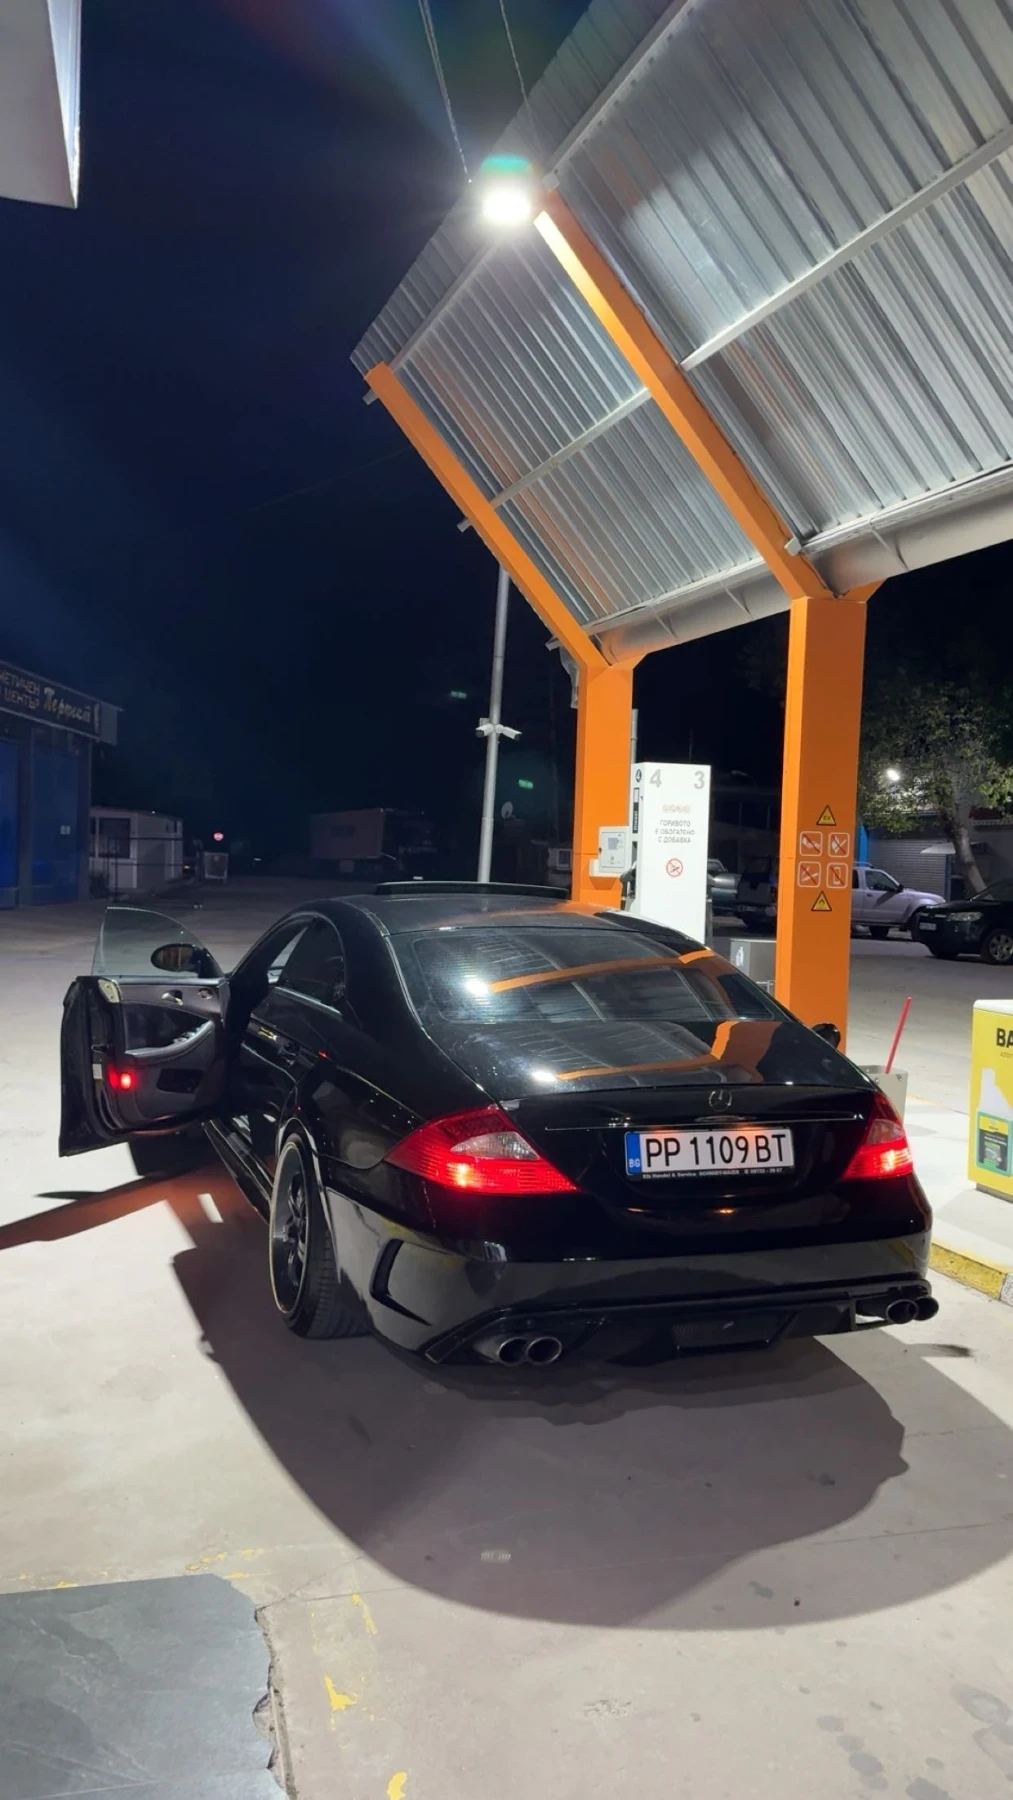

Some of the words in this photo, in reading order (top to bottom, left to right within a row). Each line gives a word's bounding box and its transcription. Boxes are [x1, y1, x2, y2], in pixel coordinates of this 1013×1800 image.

[649, 769, 662, 788] 4
[693, 770, 705, 789] 3
[660, 819, 691, 827] ГОРИВОТО
[628, 1159, 641, 1168] BG
